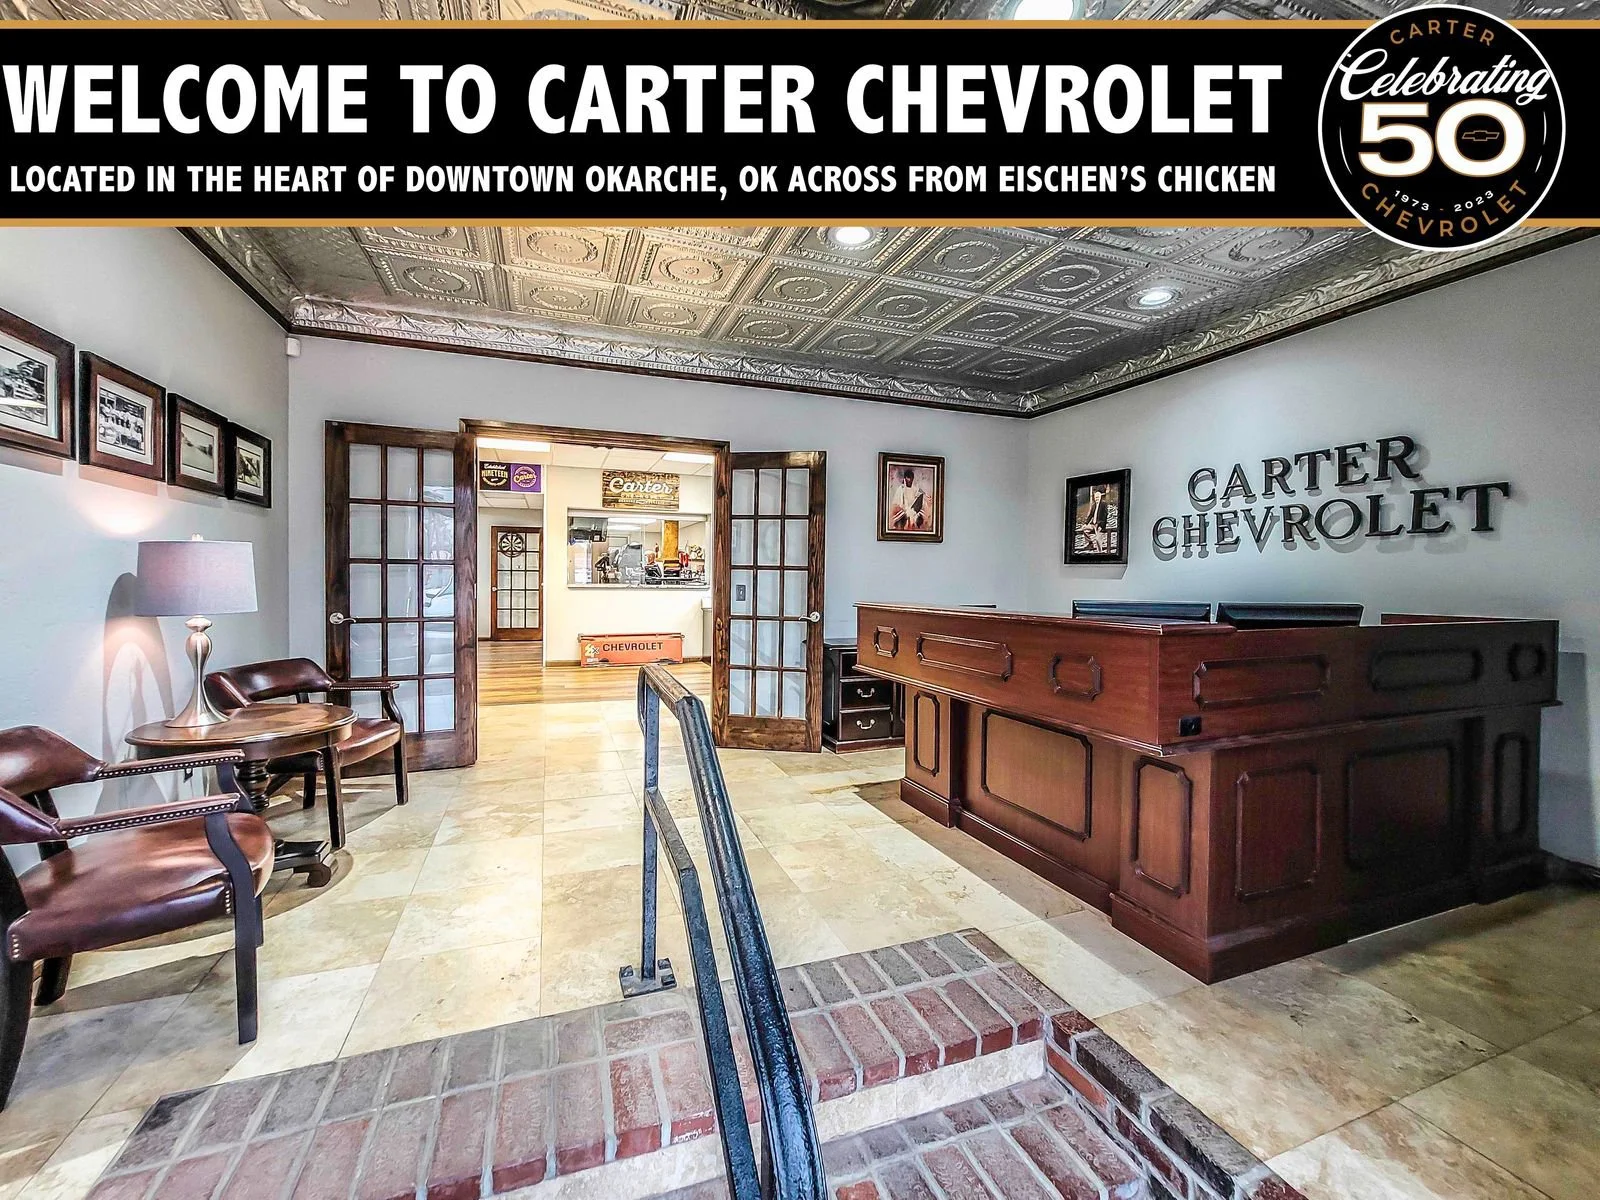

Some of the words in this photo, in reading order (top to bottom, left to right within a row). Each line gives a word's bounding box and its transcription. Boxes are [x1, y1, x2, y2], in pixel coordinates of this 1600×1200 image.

[609, 477, 673, 494] Carter
[1188, 435, 1420, 501] CARTER
[1152, 481, 1512, 549] CHEVROLET
[602, 642, 663, 652] CHEVROLET
